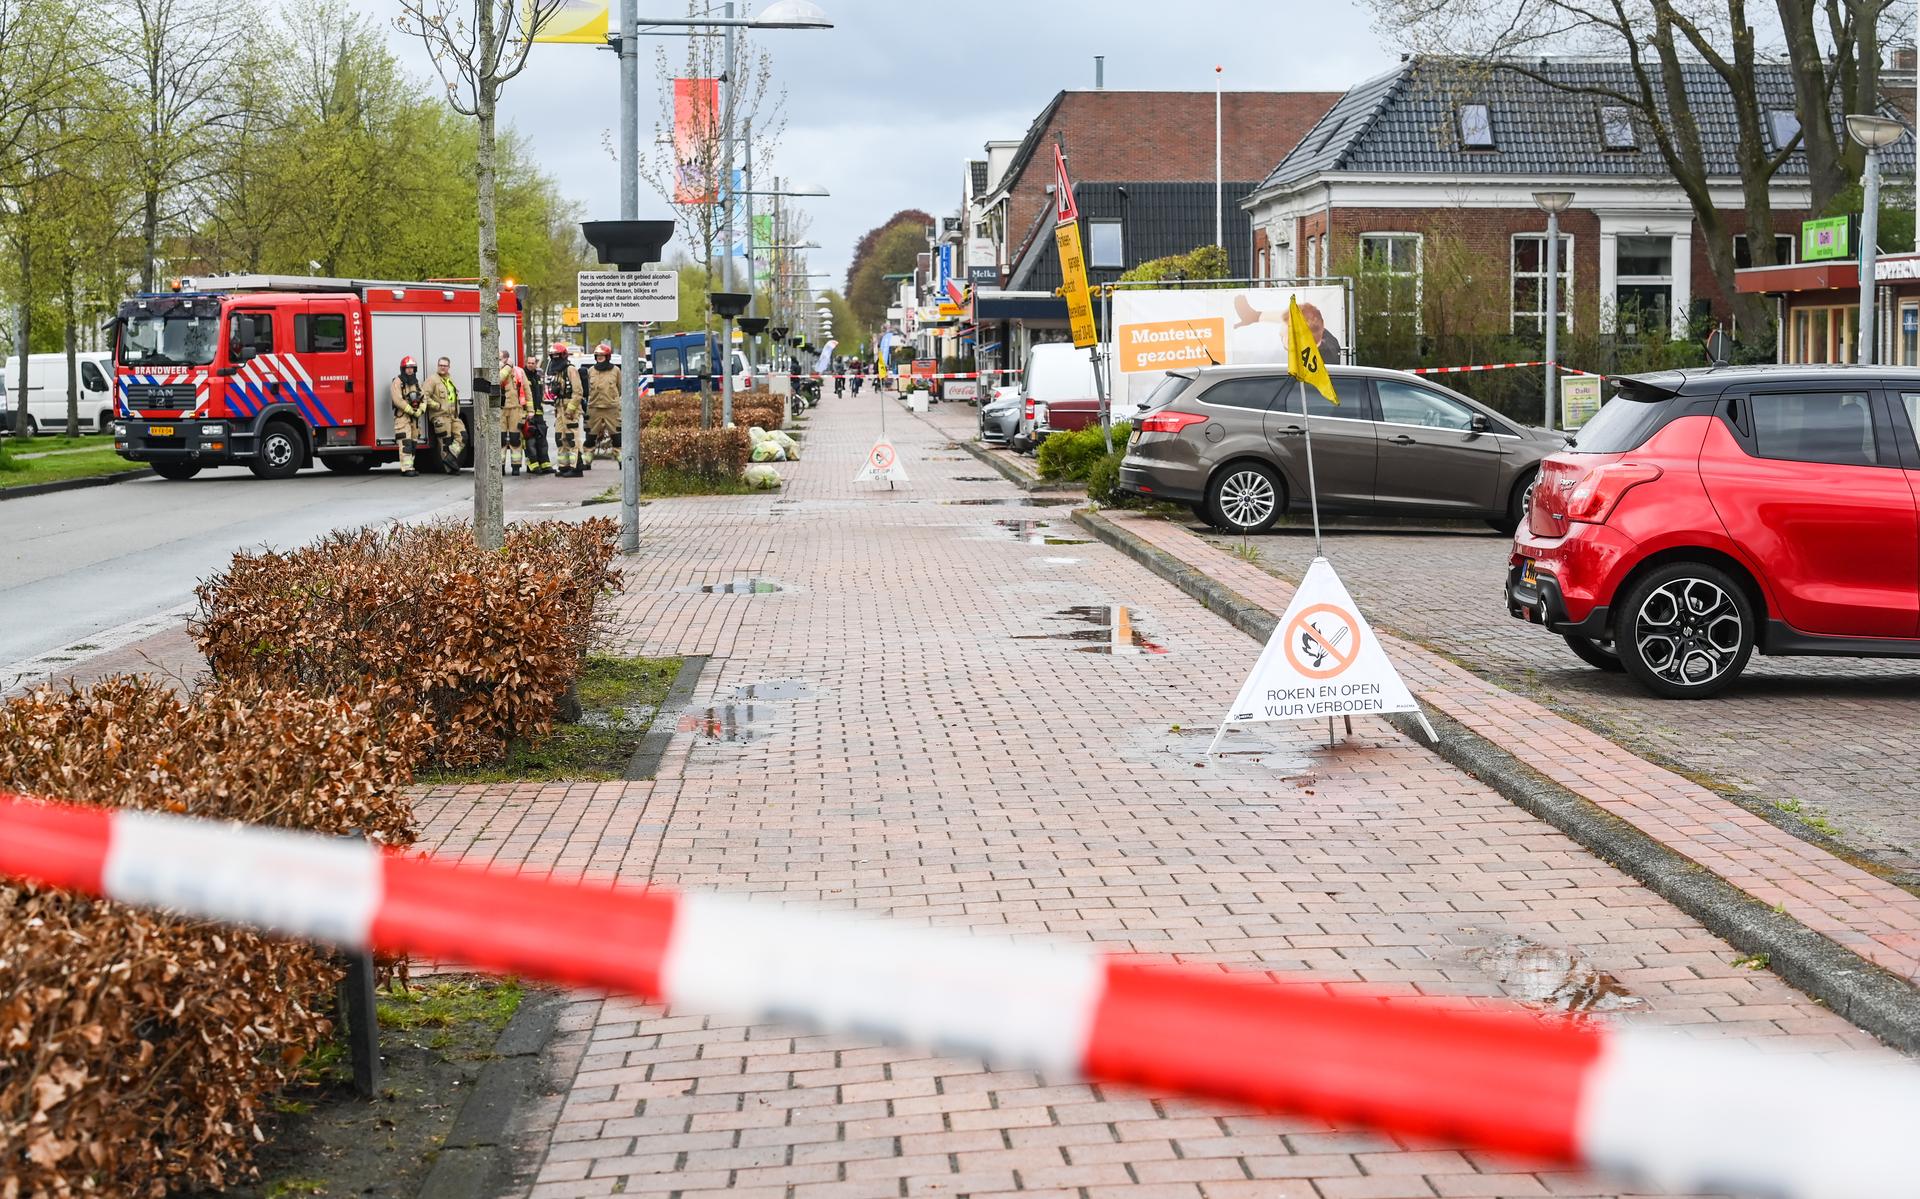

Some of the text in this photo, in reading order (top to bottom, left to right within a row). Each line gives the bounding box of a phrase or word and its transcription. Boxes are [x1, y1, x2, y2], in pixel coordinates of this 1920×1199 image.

[972, 270, 996, 278] Melka
[352, 311, 362, 356] 01-2133
[1130, 327, 1212, 344] Monteurs
[1136, 345, 1208, 367] gezocht!
[134, 366, 188, 375] BRANDWEER
[147, 389, 174, 397] MAN
[1267, 683, 1380, 701] ROKEN EN OPEN
[1264, 703, 1303, 717] VUUR
[1307, 699, 1383, 714] VERBODEN
